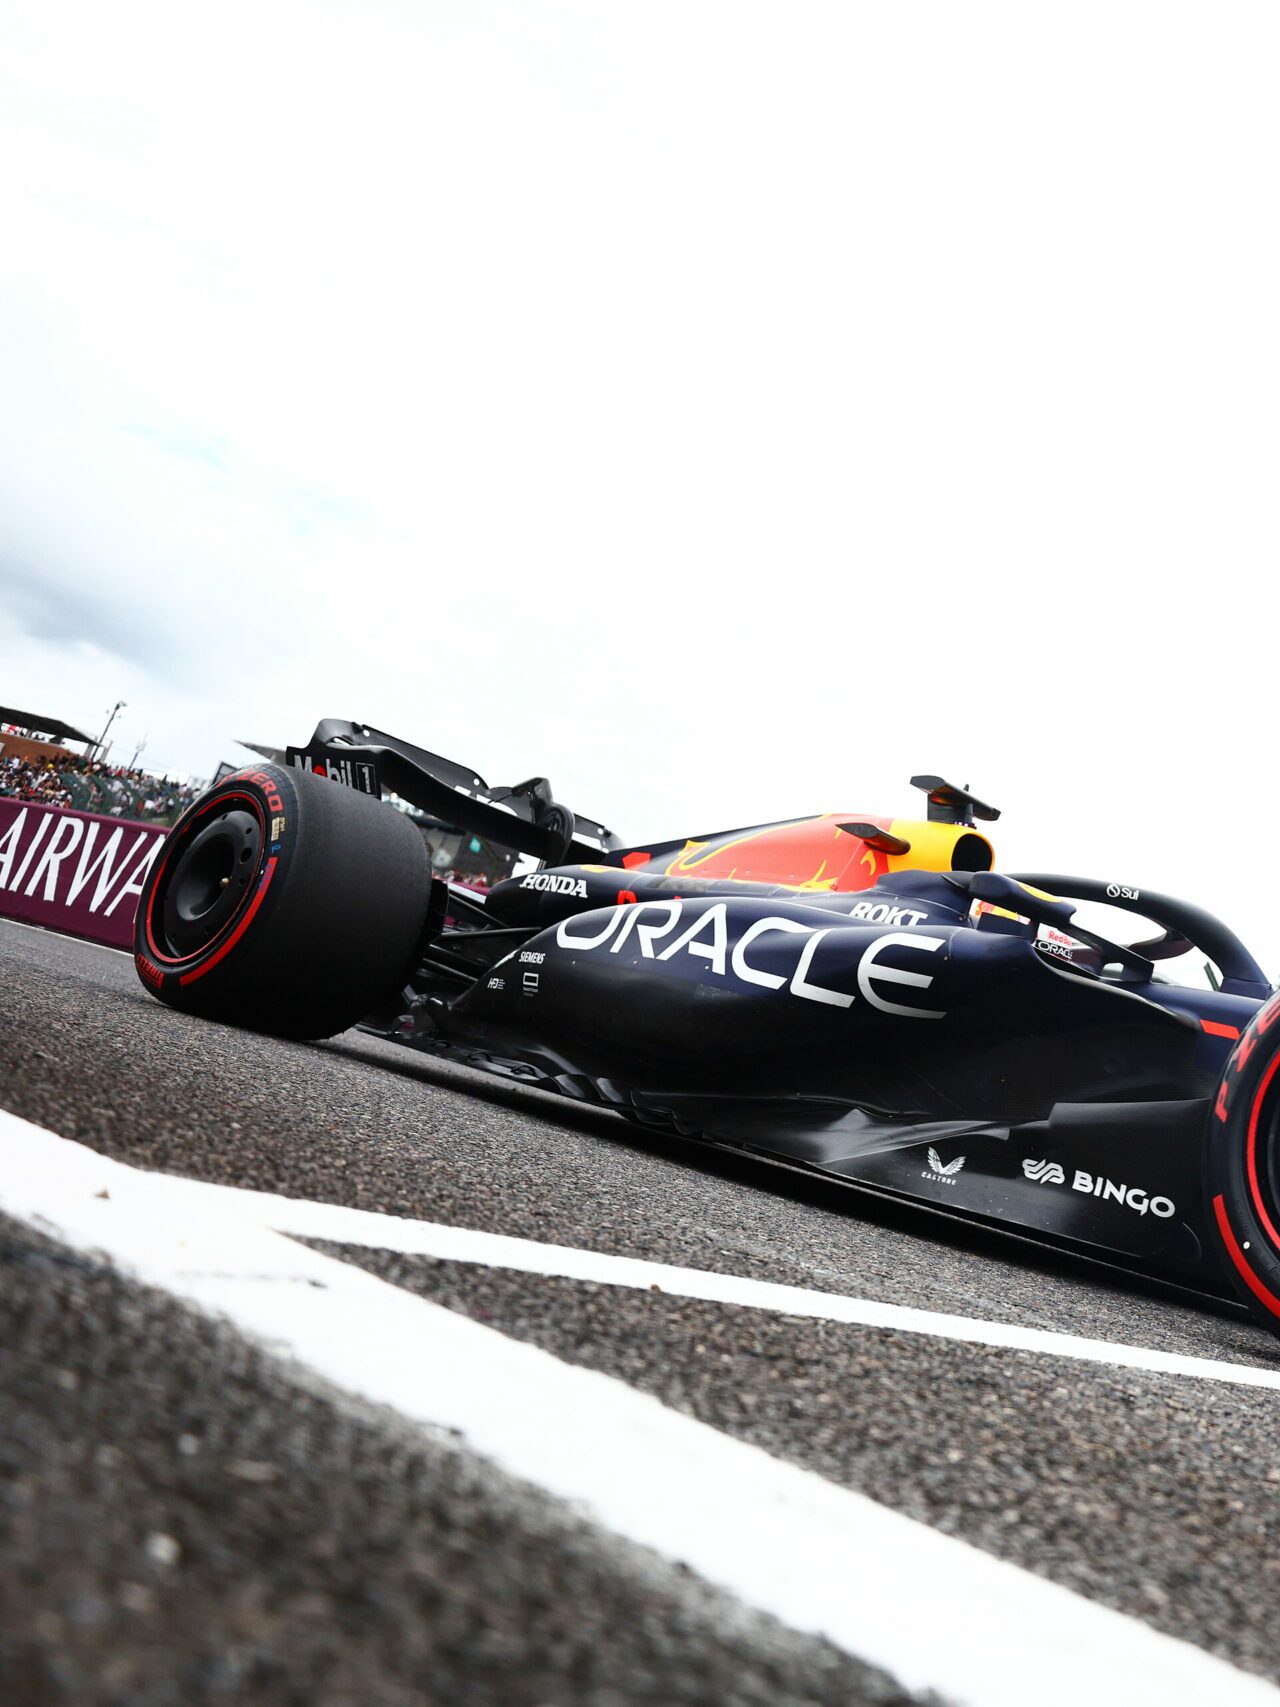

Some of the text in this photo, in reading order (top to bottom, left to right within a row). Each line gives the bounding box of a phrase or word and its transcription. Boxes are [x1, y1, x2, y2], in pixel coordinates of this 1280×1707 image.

[294, 754, 372, 793] Mobil 1
[519, 873, 588, 898] HONDA
[848, 901, 929, 927] ROKT
[519, 951, 546, 964] SIEMENS
[556, 899, 948, 1019] ORACLE
[921, 1171, 957, 1185] CASTORE
[1072, 1170, 1176, 1218] BINGO
